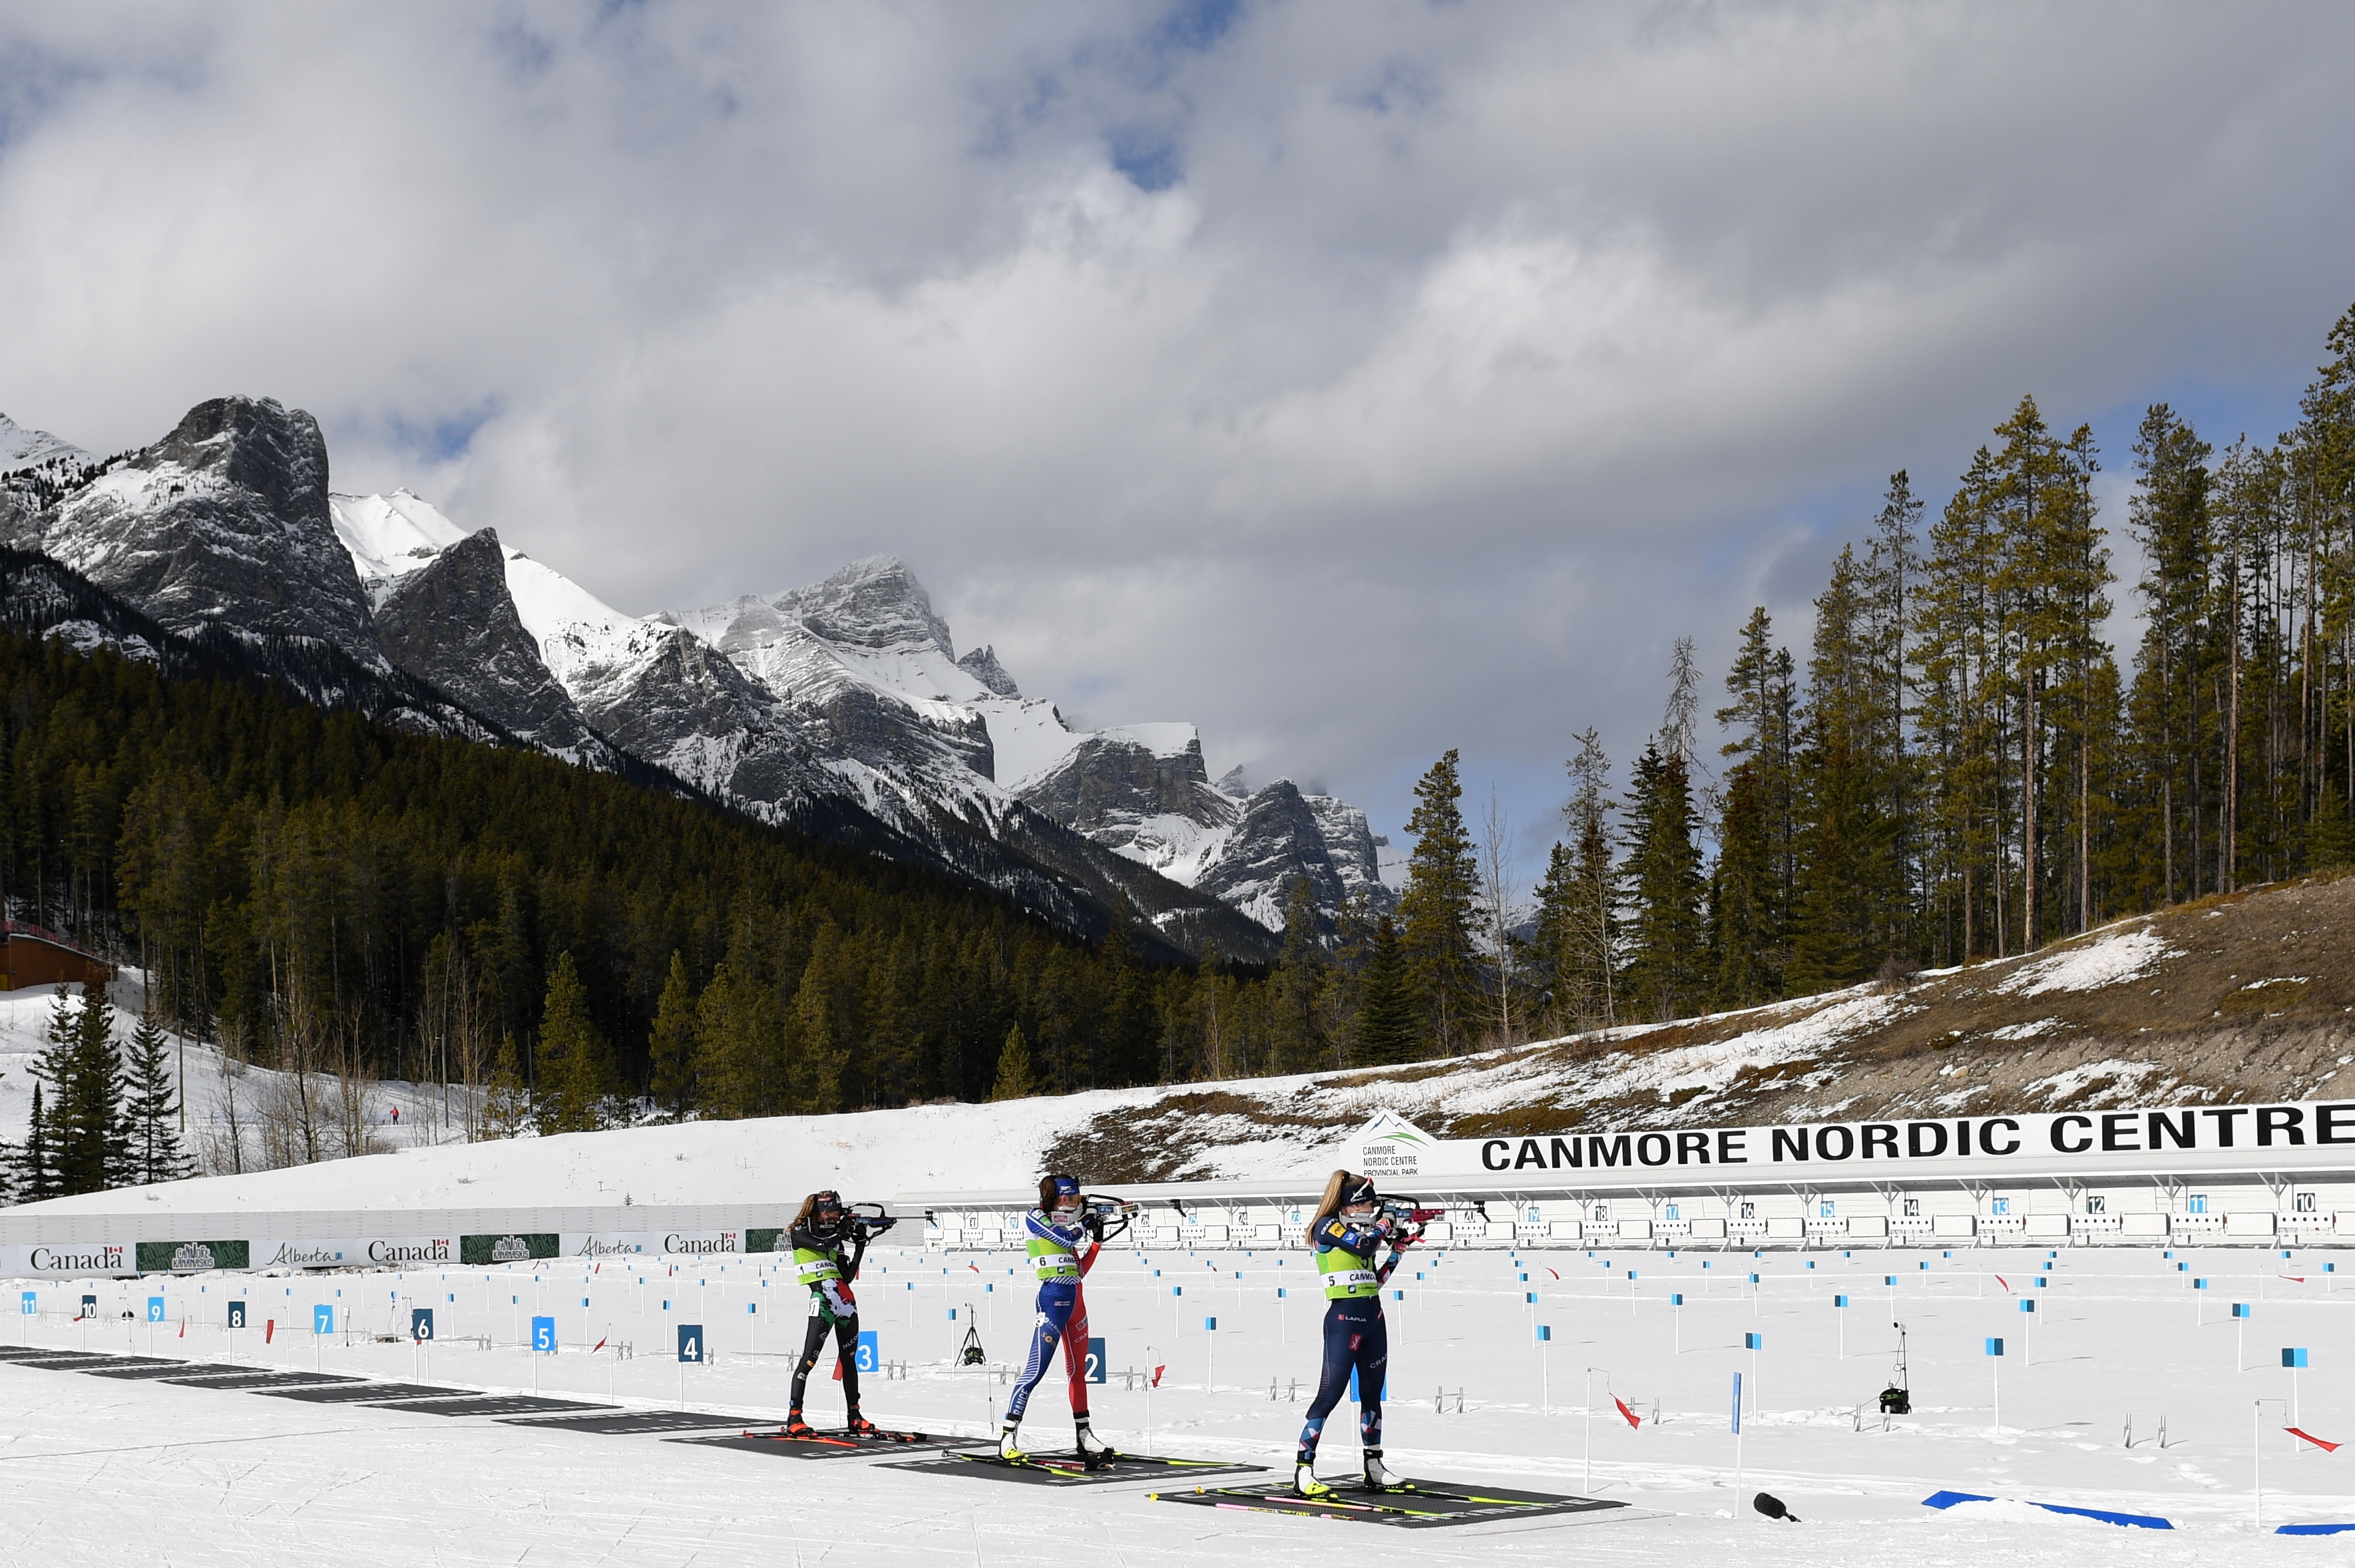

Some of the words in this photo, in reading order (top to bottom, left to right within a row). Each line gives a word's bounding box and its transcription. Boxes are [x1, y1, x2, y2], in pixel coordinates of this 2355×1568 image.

[1482, 1131, 1748, 1170] CANMORE
[1773, 1117, 2021, 1161] NORDIC
[2050, 1105, 2355, 1153] CENTRE
[1363, 1145, 1396, 1155] CANMORE
[1363, 1157, 1389, 1167] NORDIC
[1391, 1156, 1417, 1165] CENTRE
[1821, 1202, 1834, 1217] 15
[1904, 1201, 1919, 1216] 14
[1994, 1199, 2009, 1215] 13
[2089, 1198, 2104, 1214] 12
[2191, 1196, 2207, 1213] 11
[2298, 1194, 2315, 1211] 10
[1292, 1212, 1301, 1224] 23
[1465, 1211, 1475, 1222] 20
[1528, 1209, 1540, 1221] 19
[1598, 1207, 1607, 1221] 18
[1666, 1205, 1678, 1219] 17
[1741, 1203, 1754, 1218] 16
[1141, 1215, 1149, 1226] 26
[1188, 1214, 1197, 1226] 25
[1239, 1213, 1247, 1225] 24
[368, 1239, 451, 1263] Canada
[573, 1236, 641, 1257] Alberta
[664, 1233, 736, 1254] Canada
[30, 1247, 124, 1270] Canada
[266, 1242, 341, 1265] Alberta
[493, 1250, 529, 1260] KANANASKIS
[172, 1258, 214, 1269] KANANASKIS
[799, 1265, 804, 1274] 1
[1039, 1257, 1046, 1267] 6
[1329, 1275, 1335, 1286] 5
[1349, 1273, 1377, 1282] CANMO
[23, 1299, 35, 1313] 11
[83, 1302, 96, 1318] 10
[151, 1305, 161, 1321] 9
[232, 1310, 242, 1328] 8
[319, 1314, 328, 1333] 7
[418, 1318, 429, 1338] 6
[538, 1327, 550, 1350] 5
[1074, 1331, 1088, 1343] CRA
[684, 1337, 698, 1360] 4
[858, 1344, 873, 1370] 3
[1084, 1353, 1098, 1382] 2
[1012, 1388, 1030, 1416] RANCE
